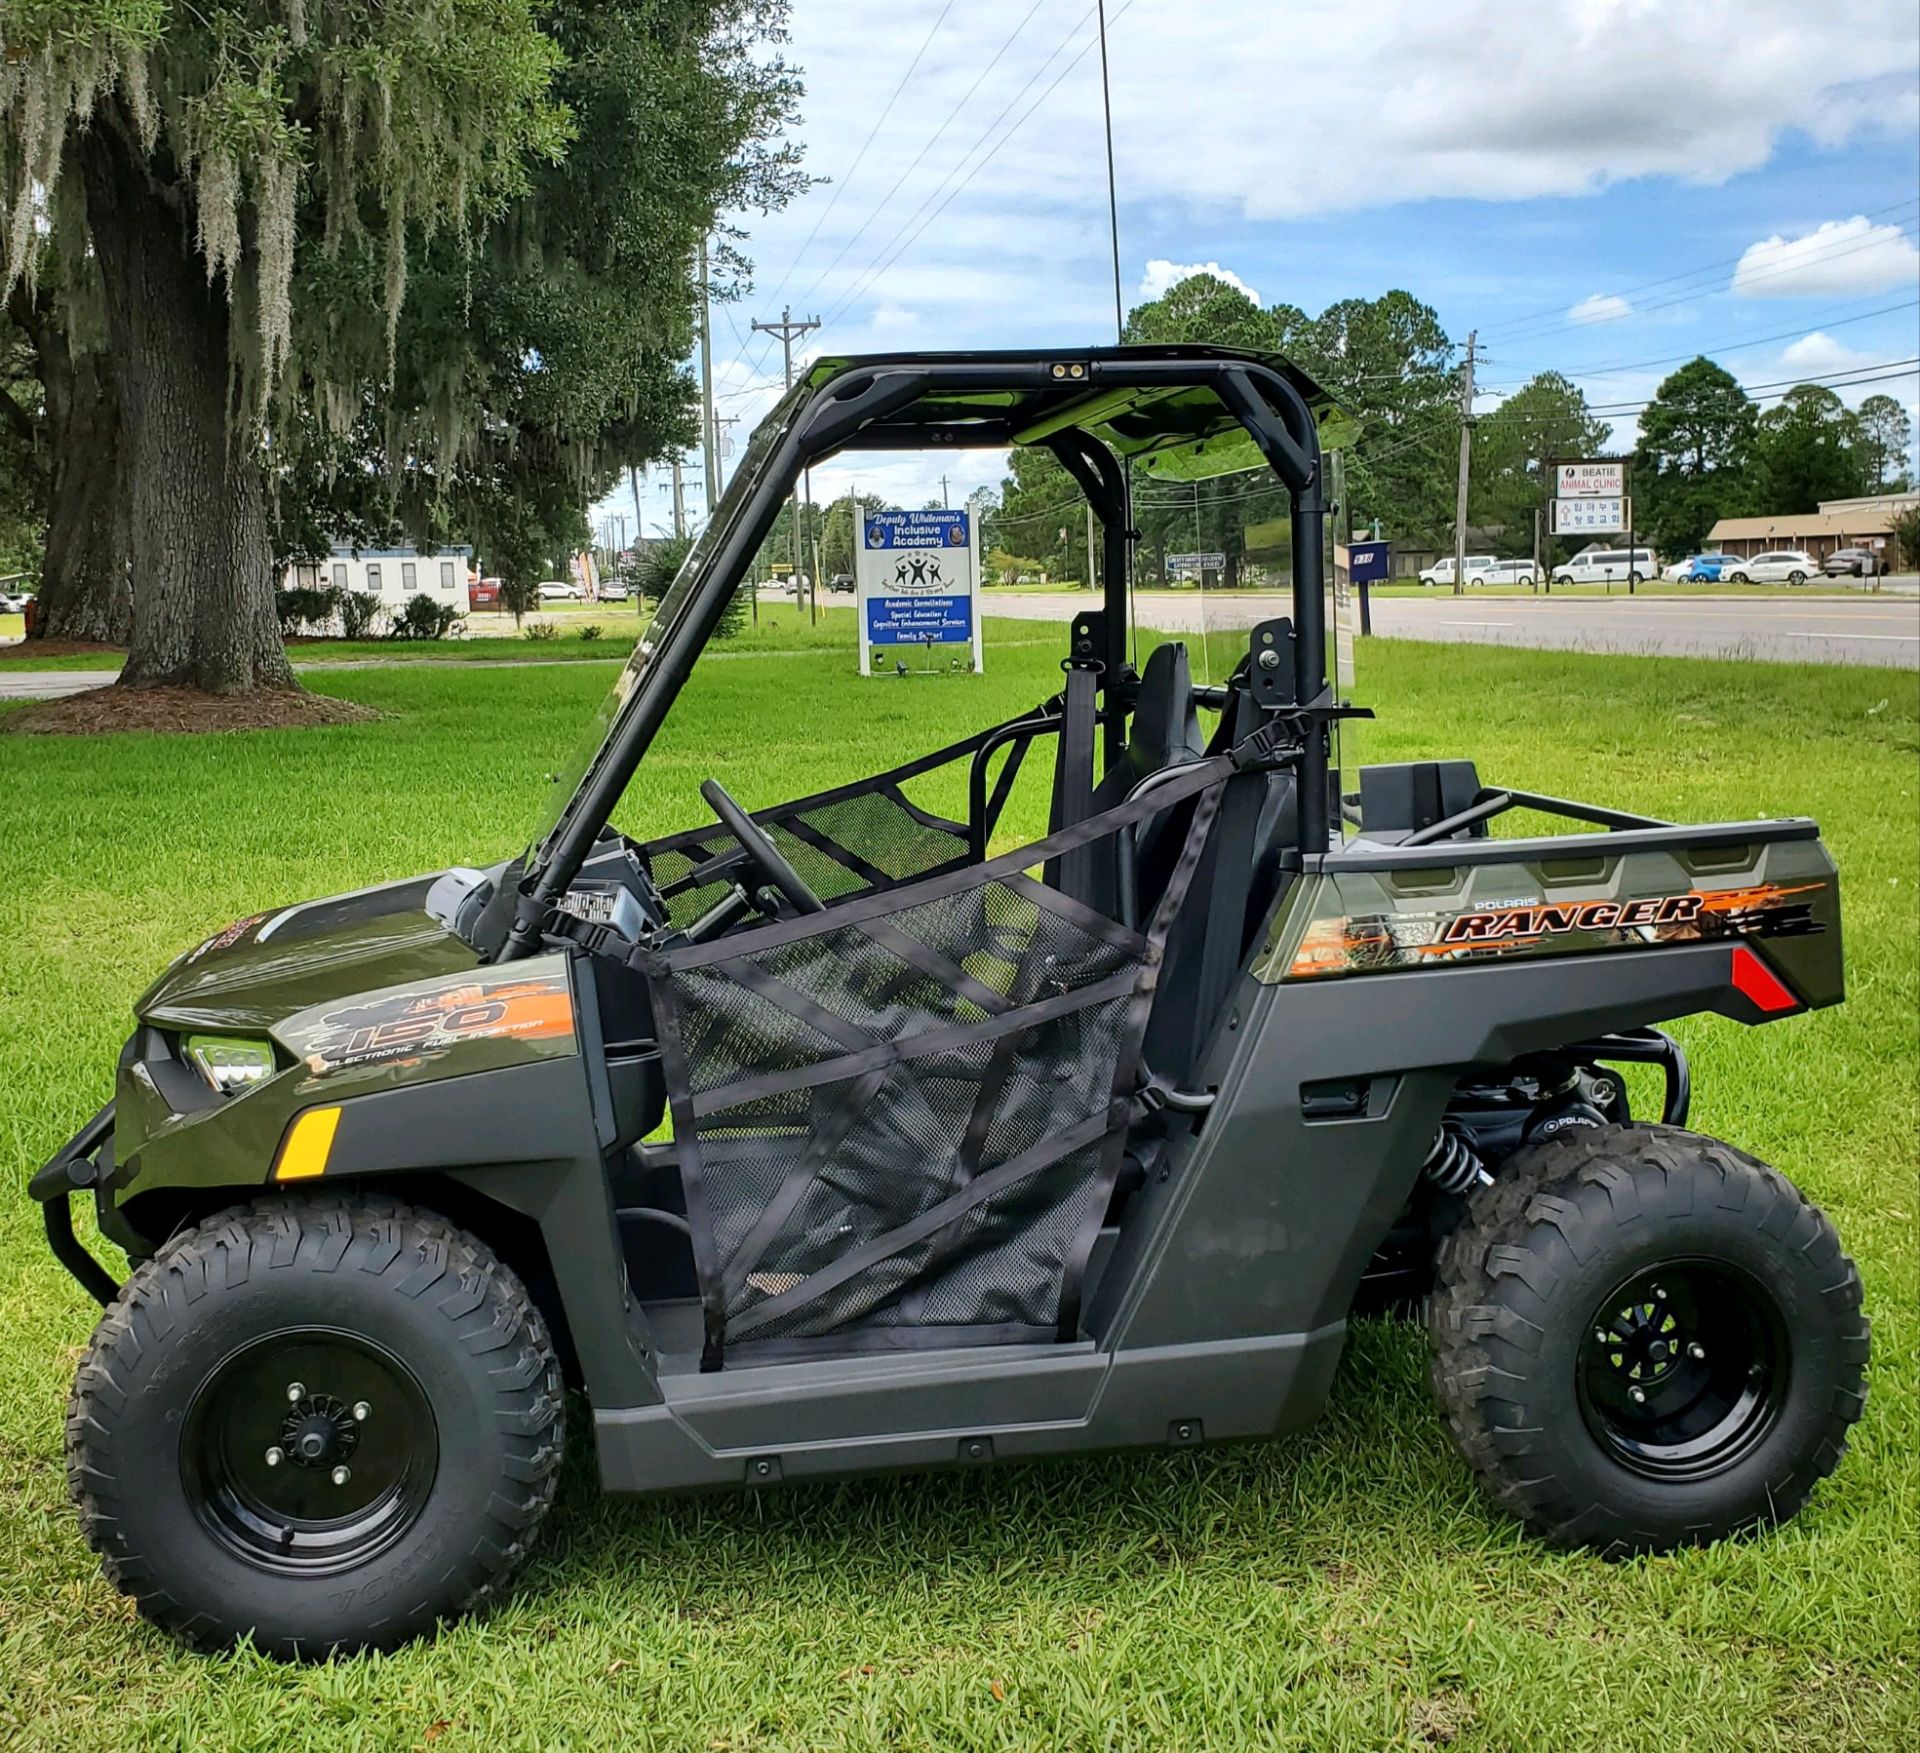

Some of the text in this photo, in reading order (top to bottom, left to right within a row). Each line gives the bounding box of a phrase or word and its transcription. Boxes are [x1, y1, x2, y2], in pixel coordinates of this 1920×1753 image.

[1583, 468, 1616, 477] BEATIE
[1560, 478, 1620, 489] ANIMAL CLINIC
[873, 511, 961, 526] Deputy Whiteman's
[894, 525, 941, 536] Inclusive
[893, 536, 943, 547] Academy
[885, 599, 912, 608] Academic
[890, 610, 912, 620] Special
[913, 609, 942, 618] Education
[873, 620, 899, 630] Cognitive
[941, 618, 966, 627] Services
[897, 631, 943, 641] Family Suort
[1474, 897, 1538, 911] POLARIS
[1444, 895, 1706, 943] RANGER
[346, 1001, 510, 1054] 150
[326, 1019, 545, 1068] ELECTRONIC FUEL INJECTION
